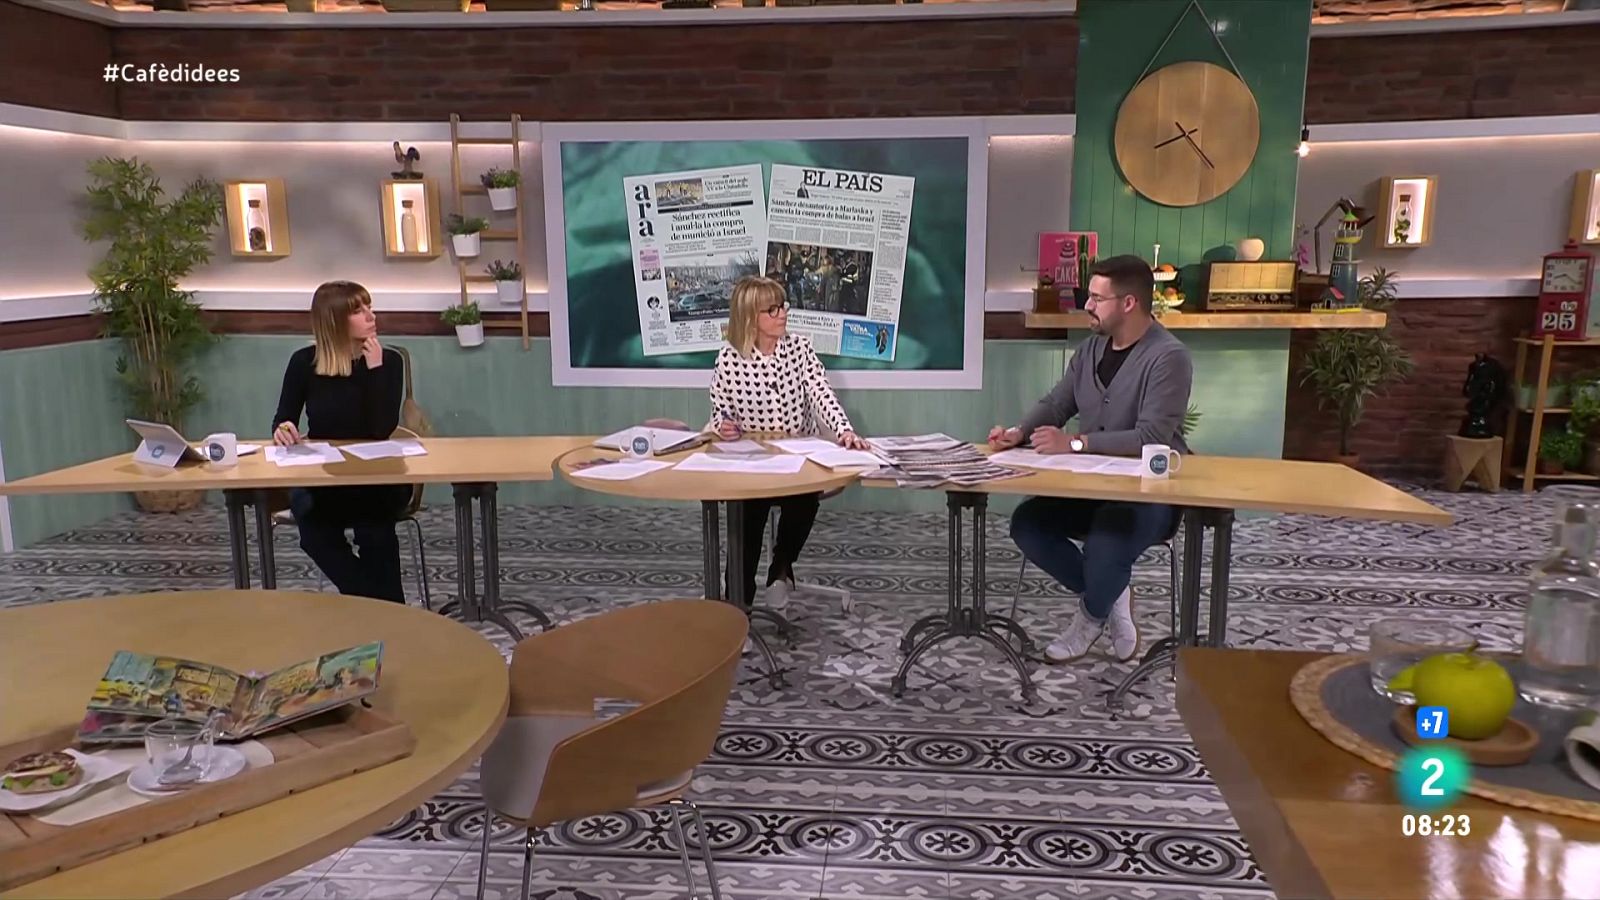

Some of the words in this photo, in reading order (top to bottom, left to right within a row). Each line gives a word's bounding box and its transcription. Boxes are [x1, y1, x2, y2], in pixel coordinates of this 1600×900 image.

[802, 169, 831, 188] EL
[634, 184, 655, 237] ara
[672, 212, 706, 222] Sánchez
[707, 208, 741, 219] rectifica
[770, 207, 794, 215] cancela
[801, 210, 825, 219] compra
[826, 211, 833, 219] de
[857, 214, 874, 222] Israel
[703, 220, 711, 229] la
[712, 219, 744, 228] compra
[670, 232, 680, 241] de
[682, 228, 715, 240] munició
[723, 226, 746, 236] Israel
[1543, 313, 1573, 329] 25
